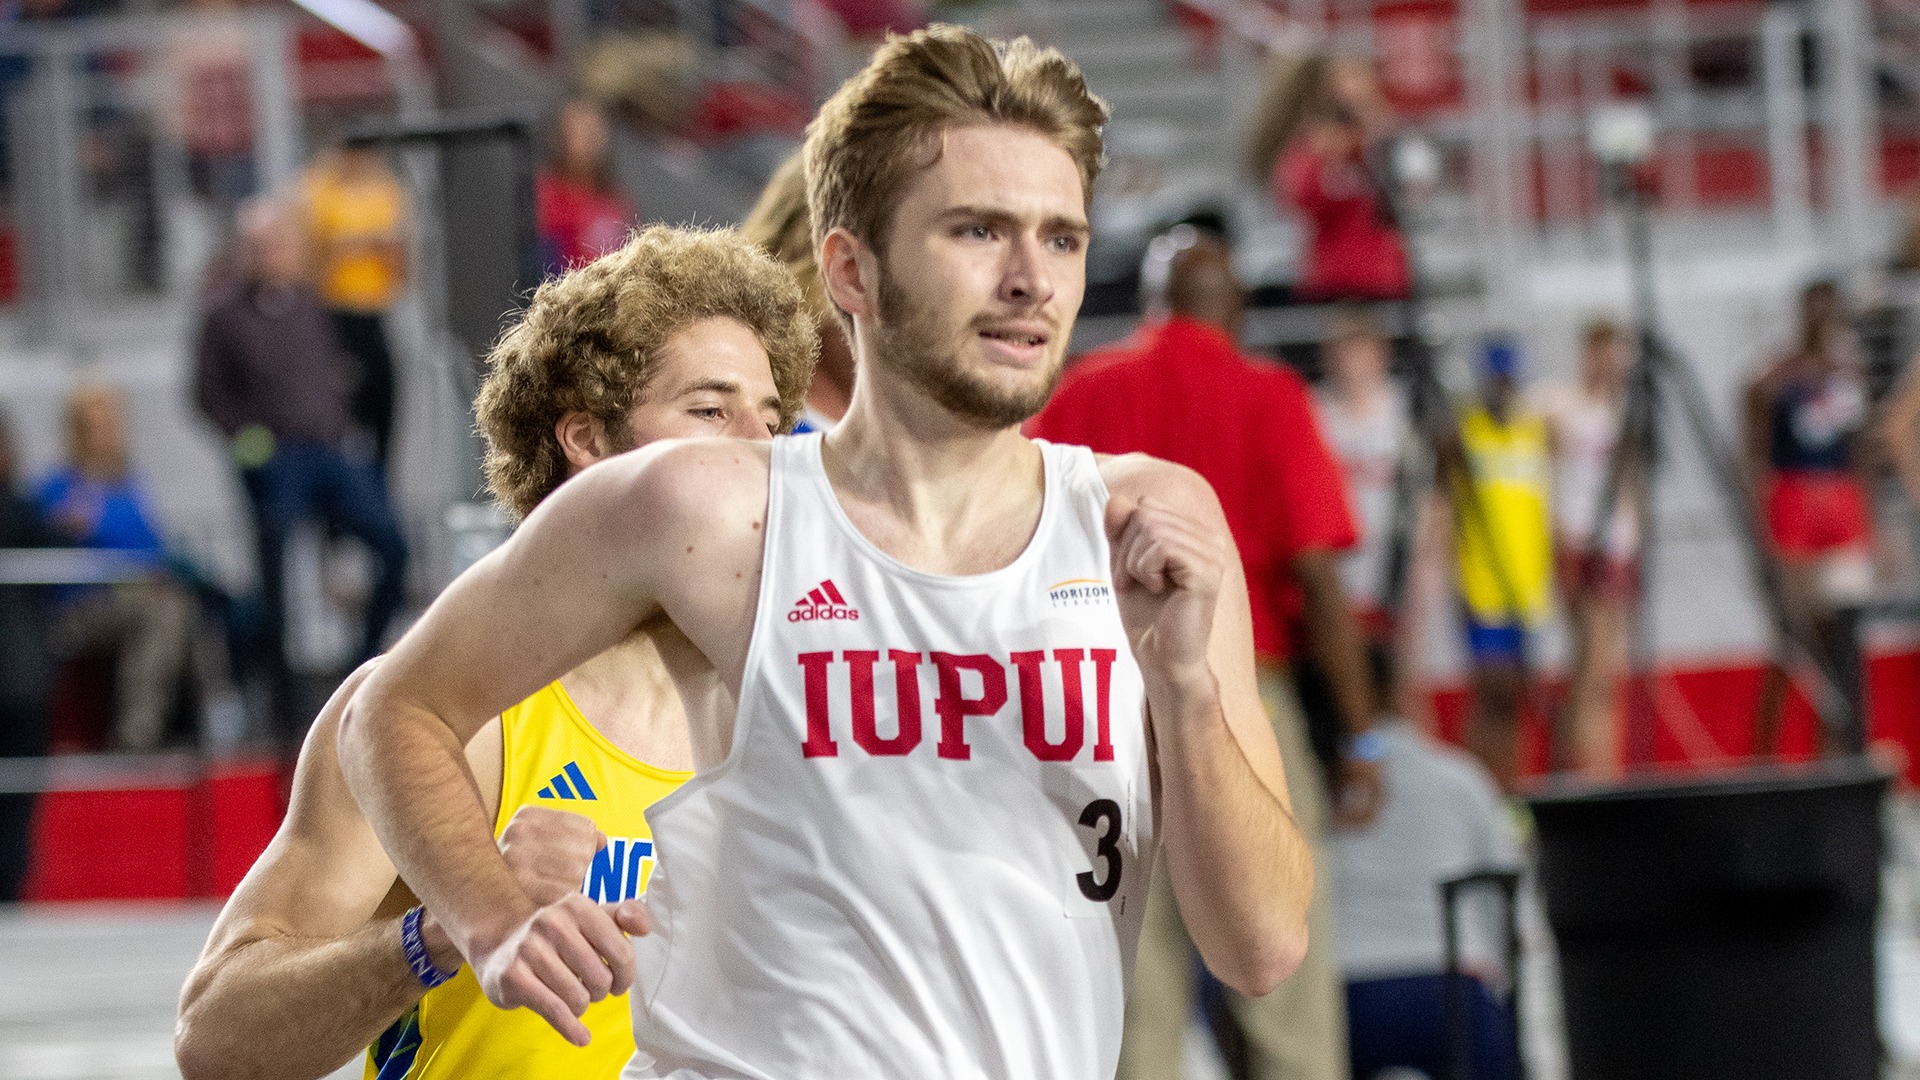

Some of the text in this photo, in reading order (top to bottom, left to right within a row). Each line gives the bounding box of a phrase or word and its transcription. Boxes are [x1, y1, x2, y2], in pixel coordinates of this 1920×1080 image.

[787, 605, 859, 623] adidas
[1049, 586, 1109, 601] HORIZON
[798, 648, 1117, 762] IUPUI
[1076, 798, 1122, 902] 3
